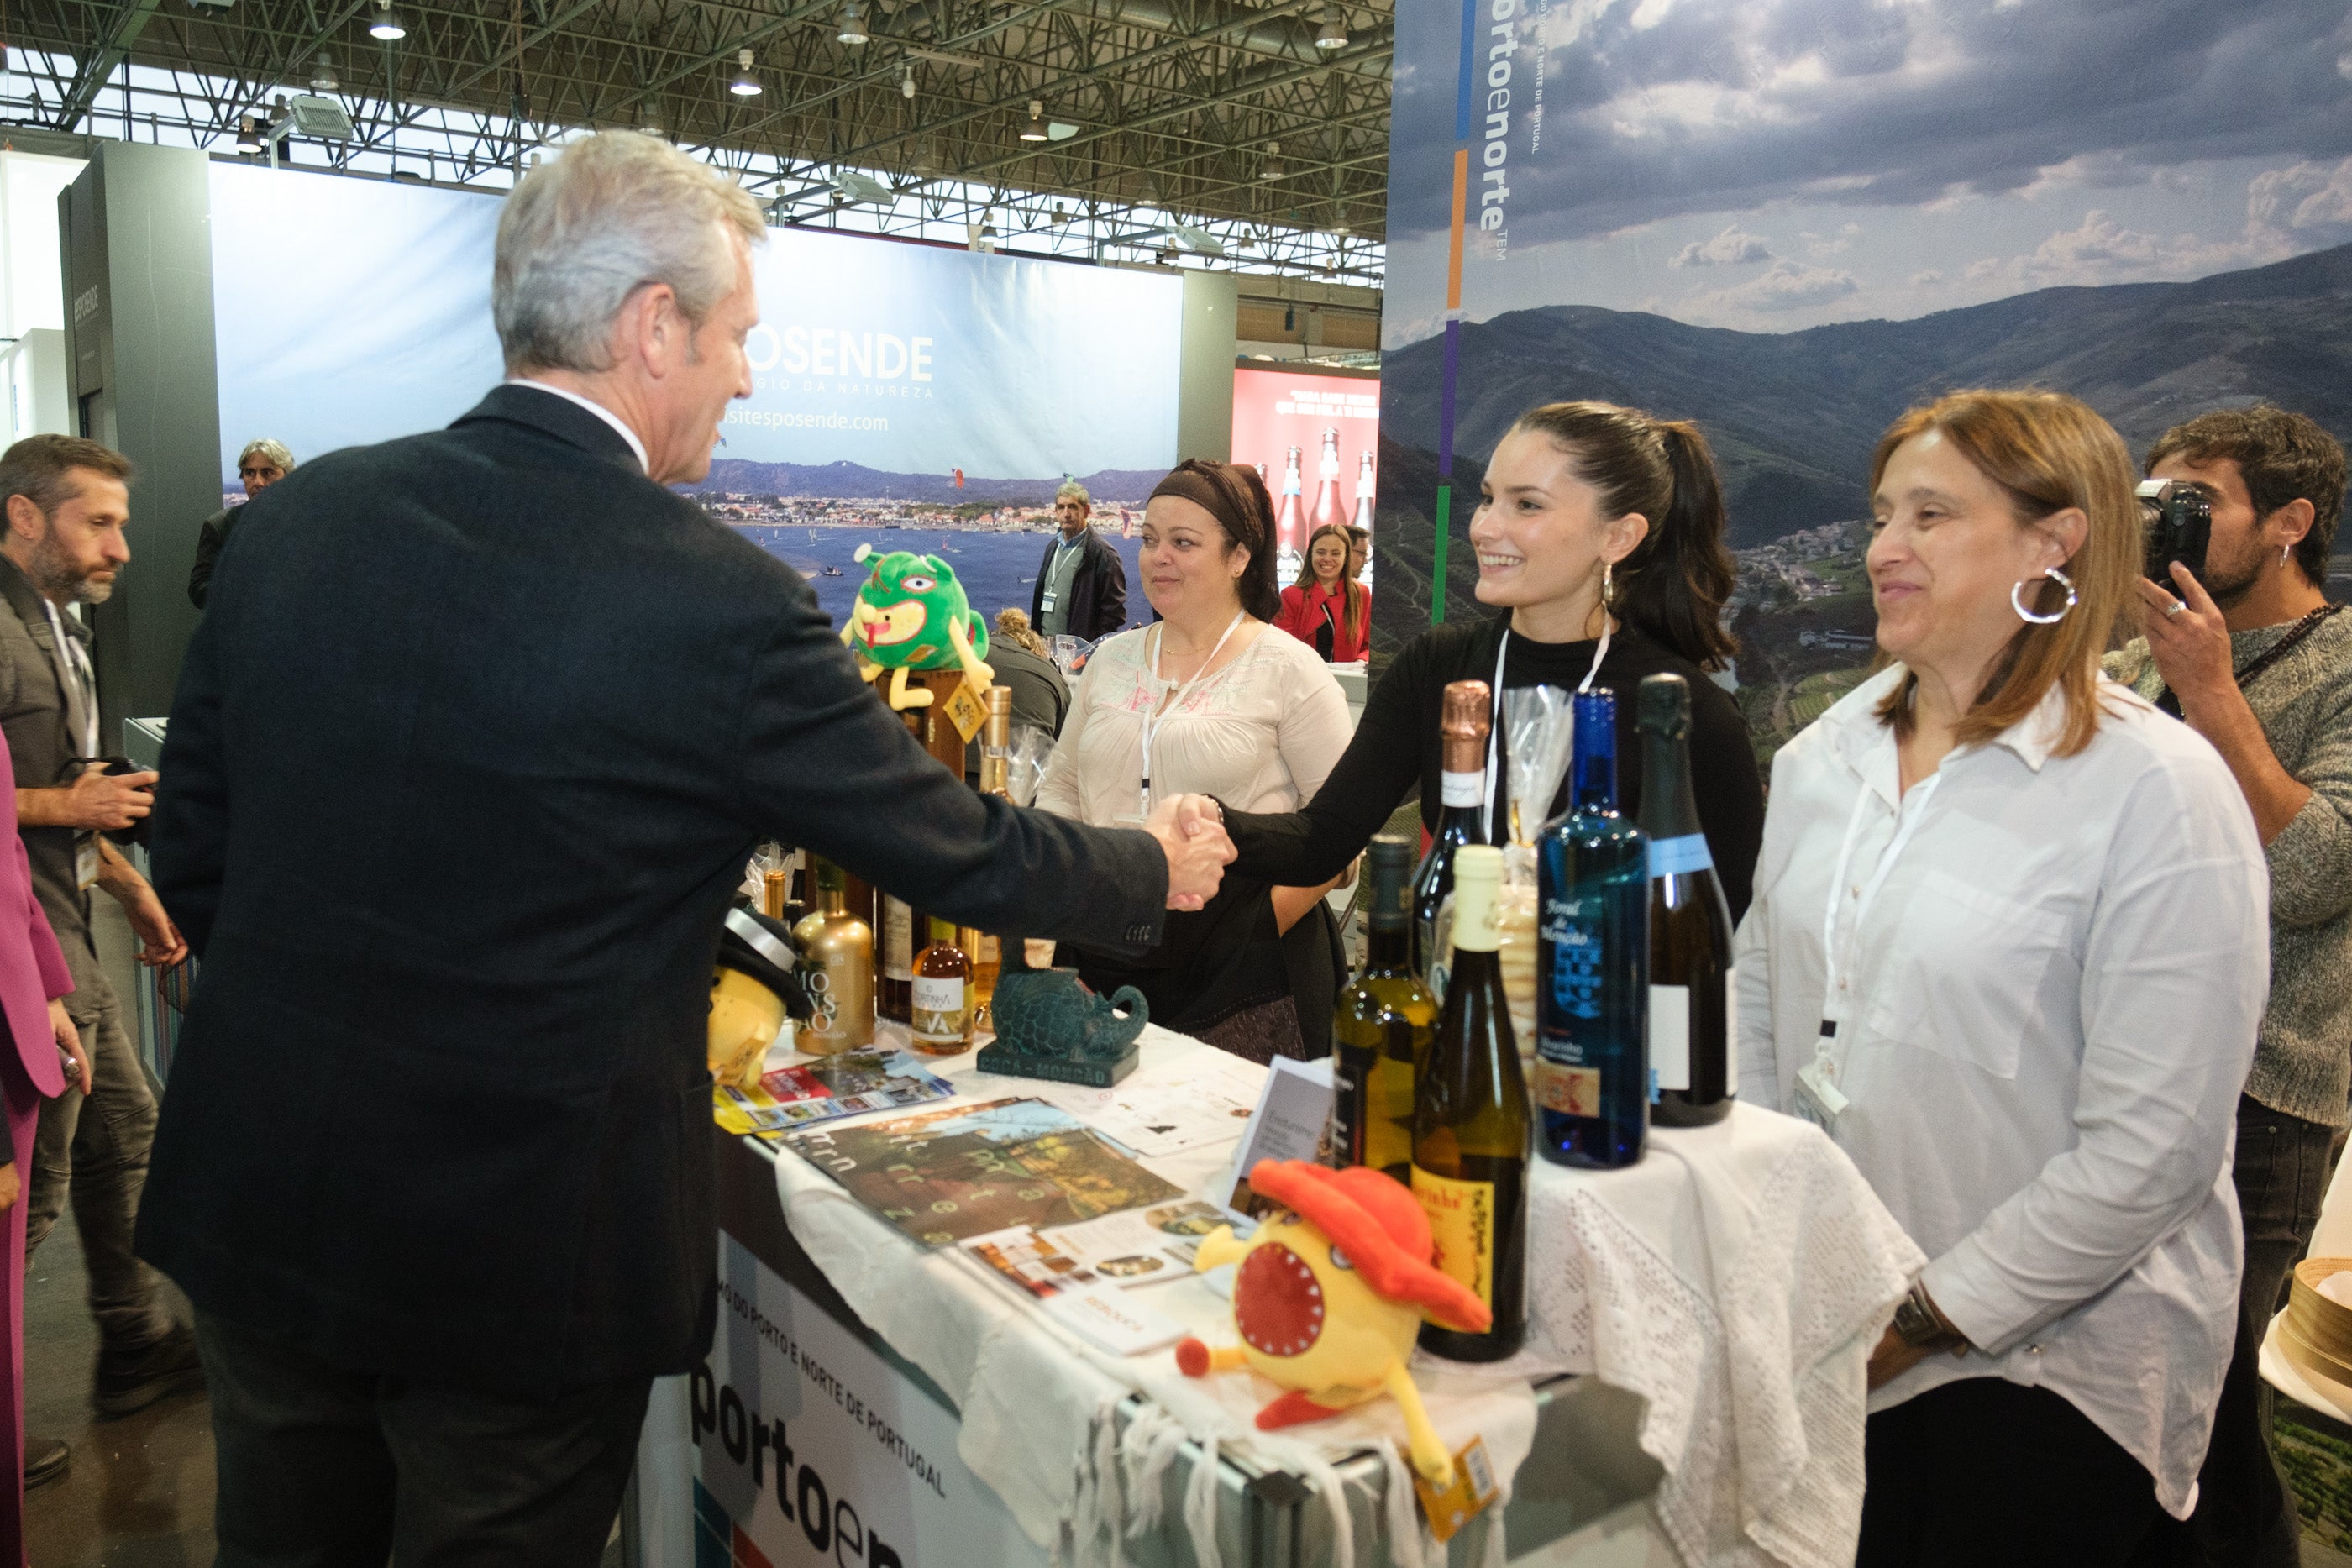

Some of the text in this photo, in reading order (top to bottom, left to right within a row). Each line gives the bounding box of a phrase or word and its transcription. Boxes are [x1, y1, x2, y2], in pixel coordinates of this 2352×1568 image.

[1538, 13, 1546, 45] PORTO
[1536, 55, 1545, 87] NORTE
[1535, 90, 1543, 102] DE
[1531, 104, 1543, 155] PORTUGAL
[802, 381, 826, 392] DA
[838, 383, 934, 400] NATUREZA
[750, 1306, 789, 1356] PORTO
[790, 1342, 798, 1366] E
[801, 1350, 844, 1407] NORTE
[846, 1390, 864, 1425] DE
[867, 1408, 947, 1500] PORTUGAL
